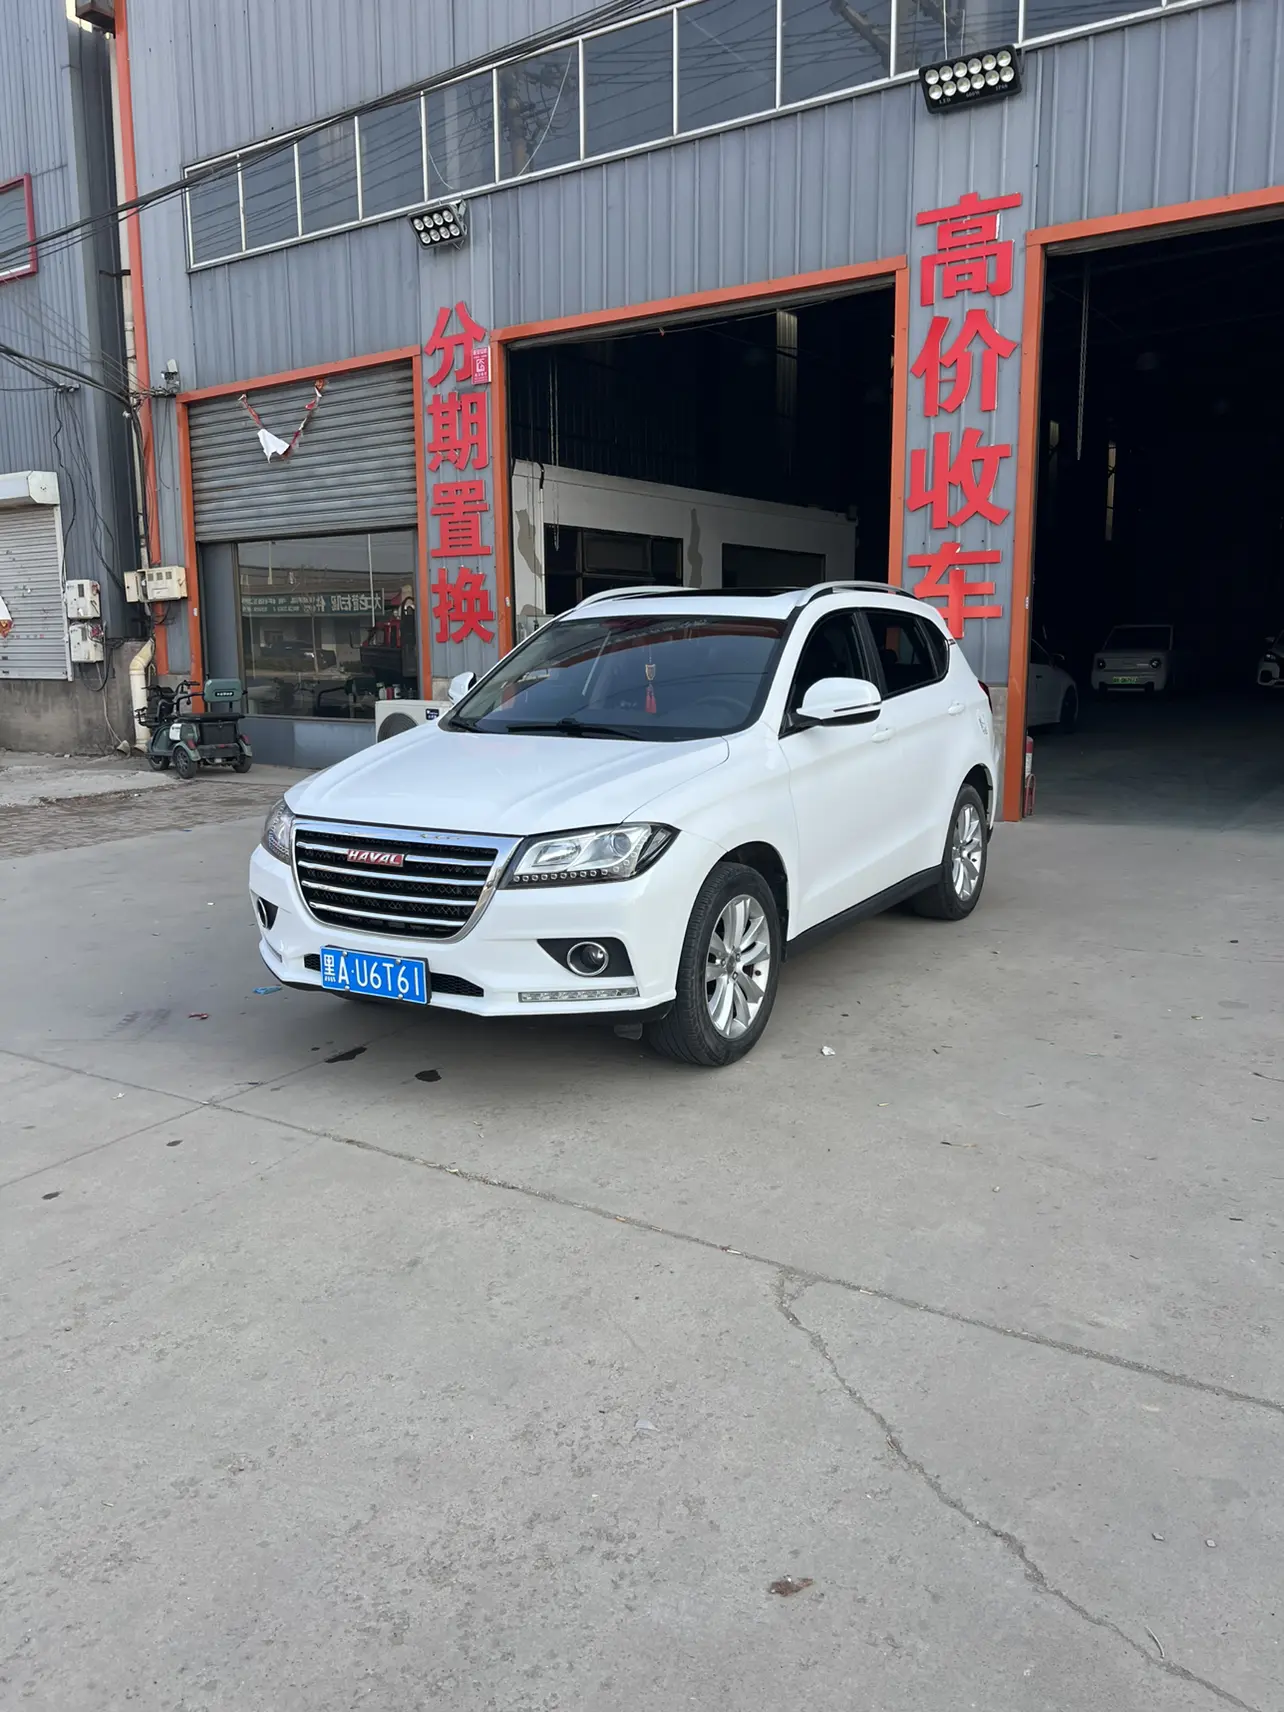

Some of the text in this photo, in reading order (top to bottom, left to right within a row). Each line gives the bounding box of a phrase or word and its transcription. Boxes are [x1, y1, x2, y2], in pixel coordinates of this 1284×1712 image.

[424, 300, 495, 644] 分期置换
[906, 192, 1022, 639] 高价收车
[347, 849, 404, 867] HAVAL
